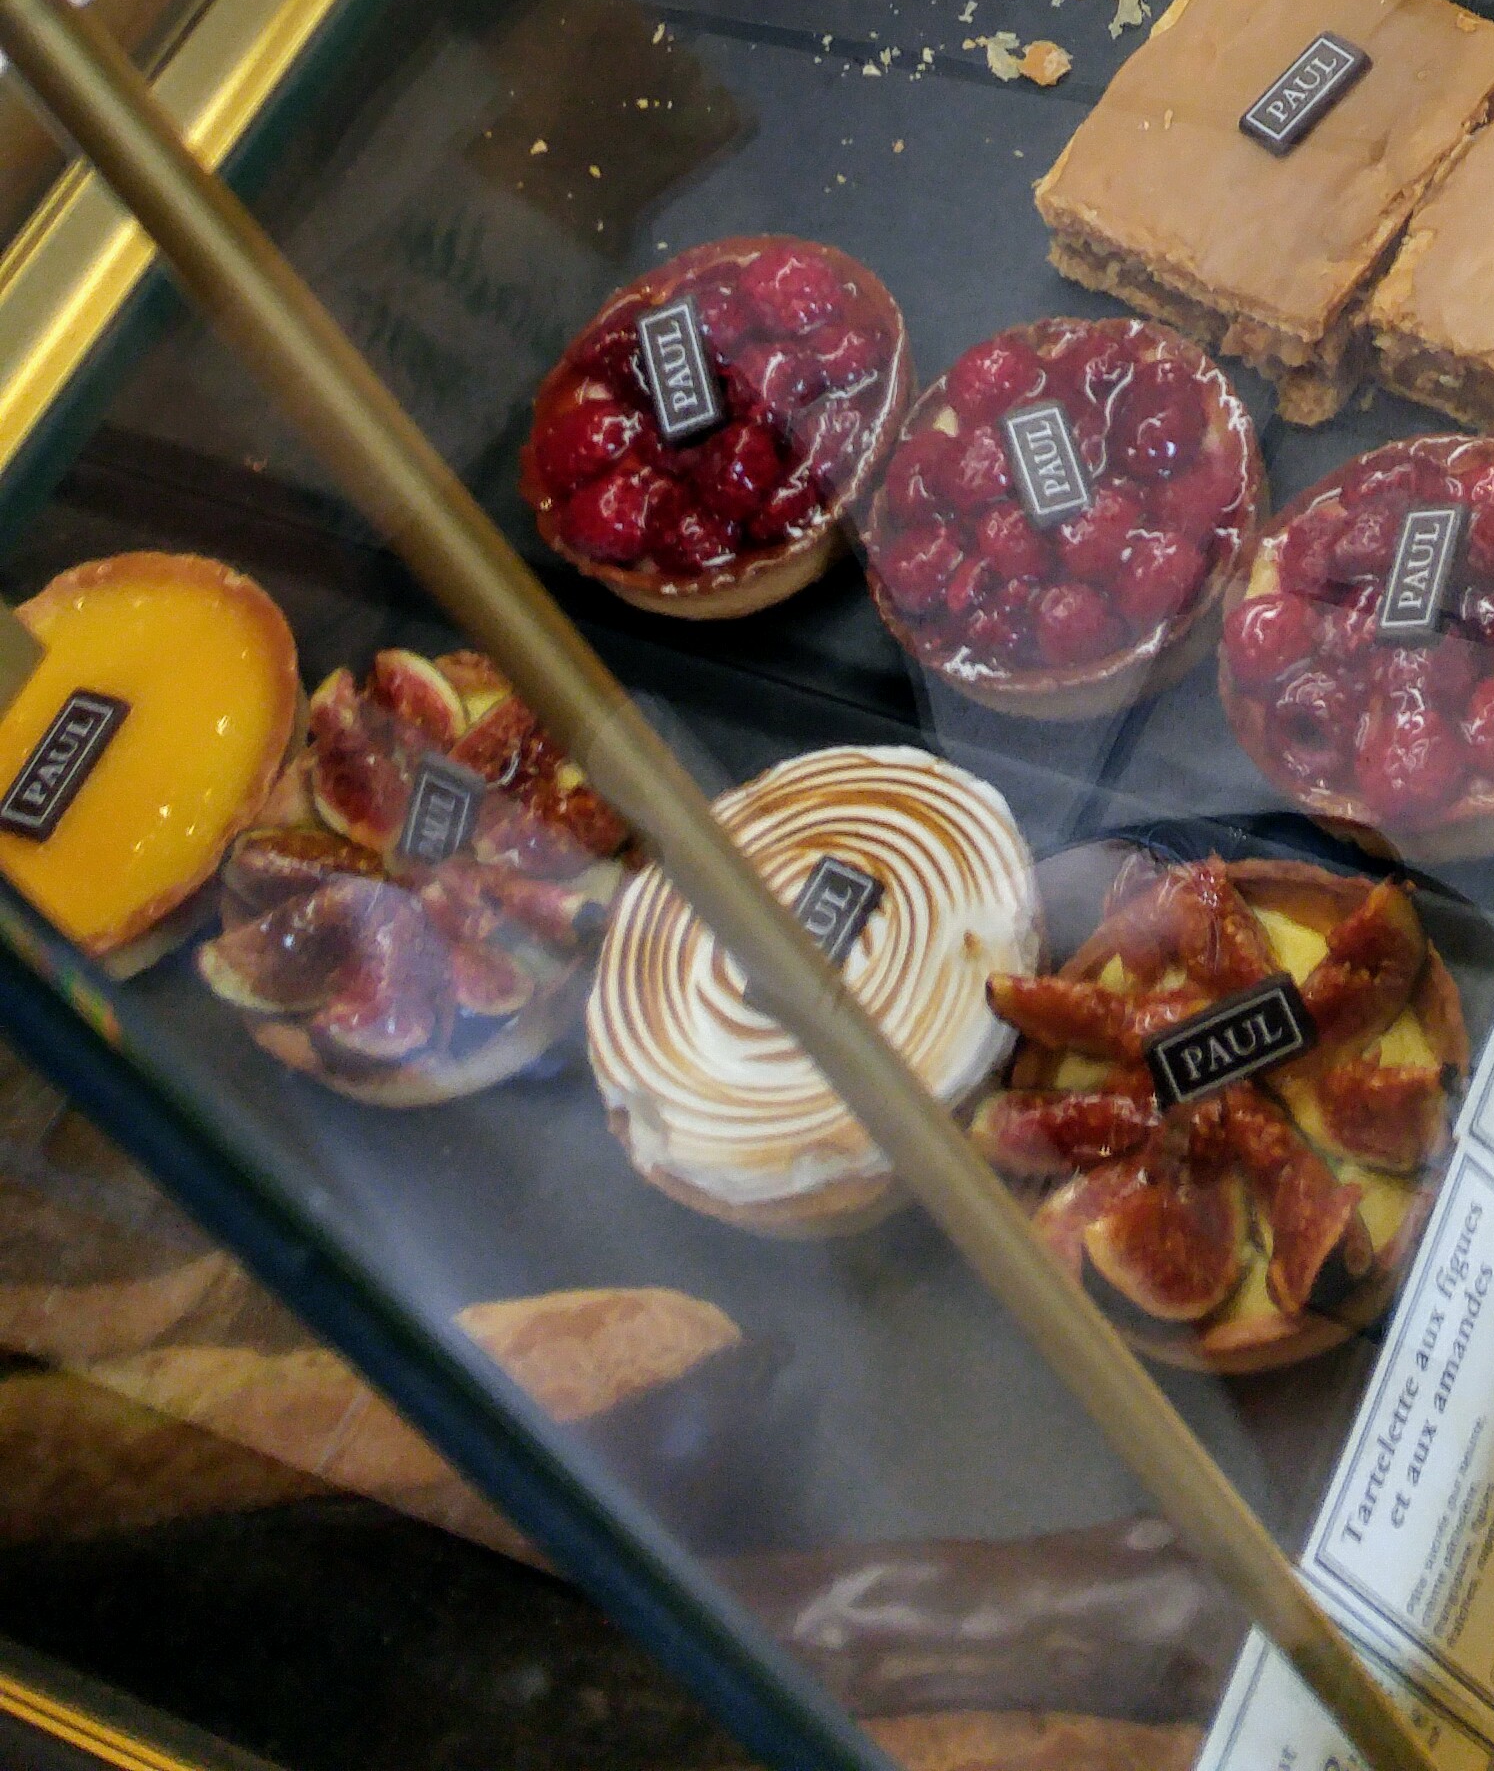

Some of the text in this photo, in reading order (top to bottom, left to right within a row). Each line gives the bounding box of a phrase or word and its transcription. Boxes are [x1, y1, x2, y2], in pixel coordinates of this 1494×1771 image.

[1266, 57, 1337, 122] PAUL
[657, 320, 698, 412] PAUL
[1025, 420, 1071, 498] PAUL
[1398, 523, 1440, 609] PAUL
[23, 718, 94, 806] PAUL
[806, 886, 852, 935] UL
[1182, 1012, 1284, 1080] PAUL
[1341, 1202, 1483, 1542] Tartelette aux figues
[1390, 1266, 1492, 1528] et aux amandes
